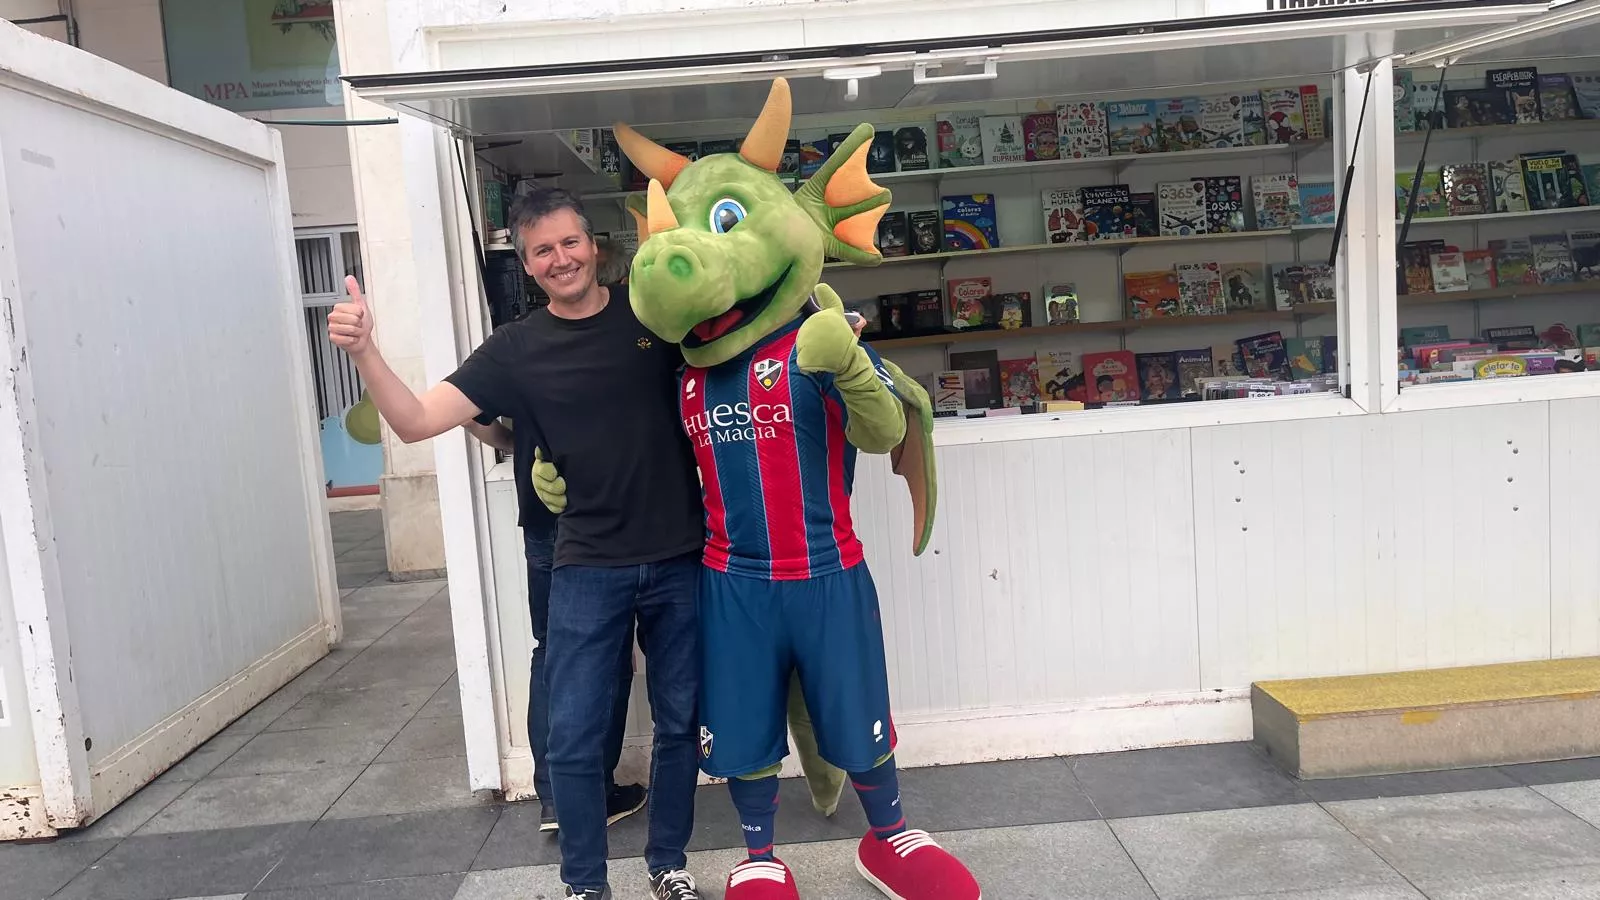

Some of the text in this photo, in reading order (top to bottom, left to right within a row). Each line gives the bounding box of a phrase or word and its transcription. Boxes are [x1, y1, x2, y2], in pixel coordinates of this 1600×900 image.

[251, 80, 278, 90] Museo
[203, 82, 249, 100] MPA
[1205, 101, 1231, 113] 365
[1063, 125, 1103, 135] ANIMALES
[1050, 191, 1081, 199] CUERP
[1168, 187, 1194, 200] 365
[1051, 197, 1082, 206] HUMAN
[1086, 197, 1129, 205] PLANETAS
[1206, 201, 1237, 211] COSAS
